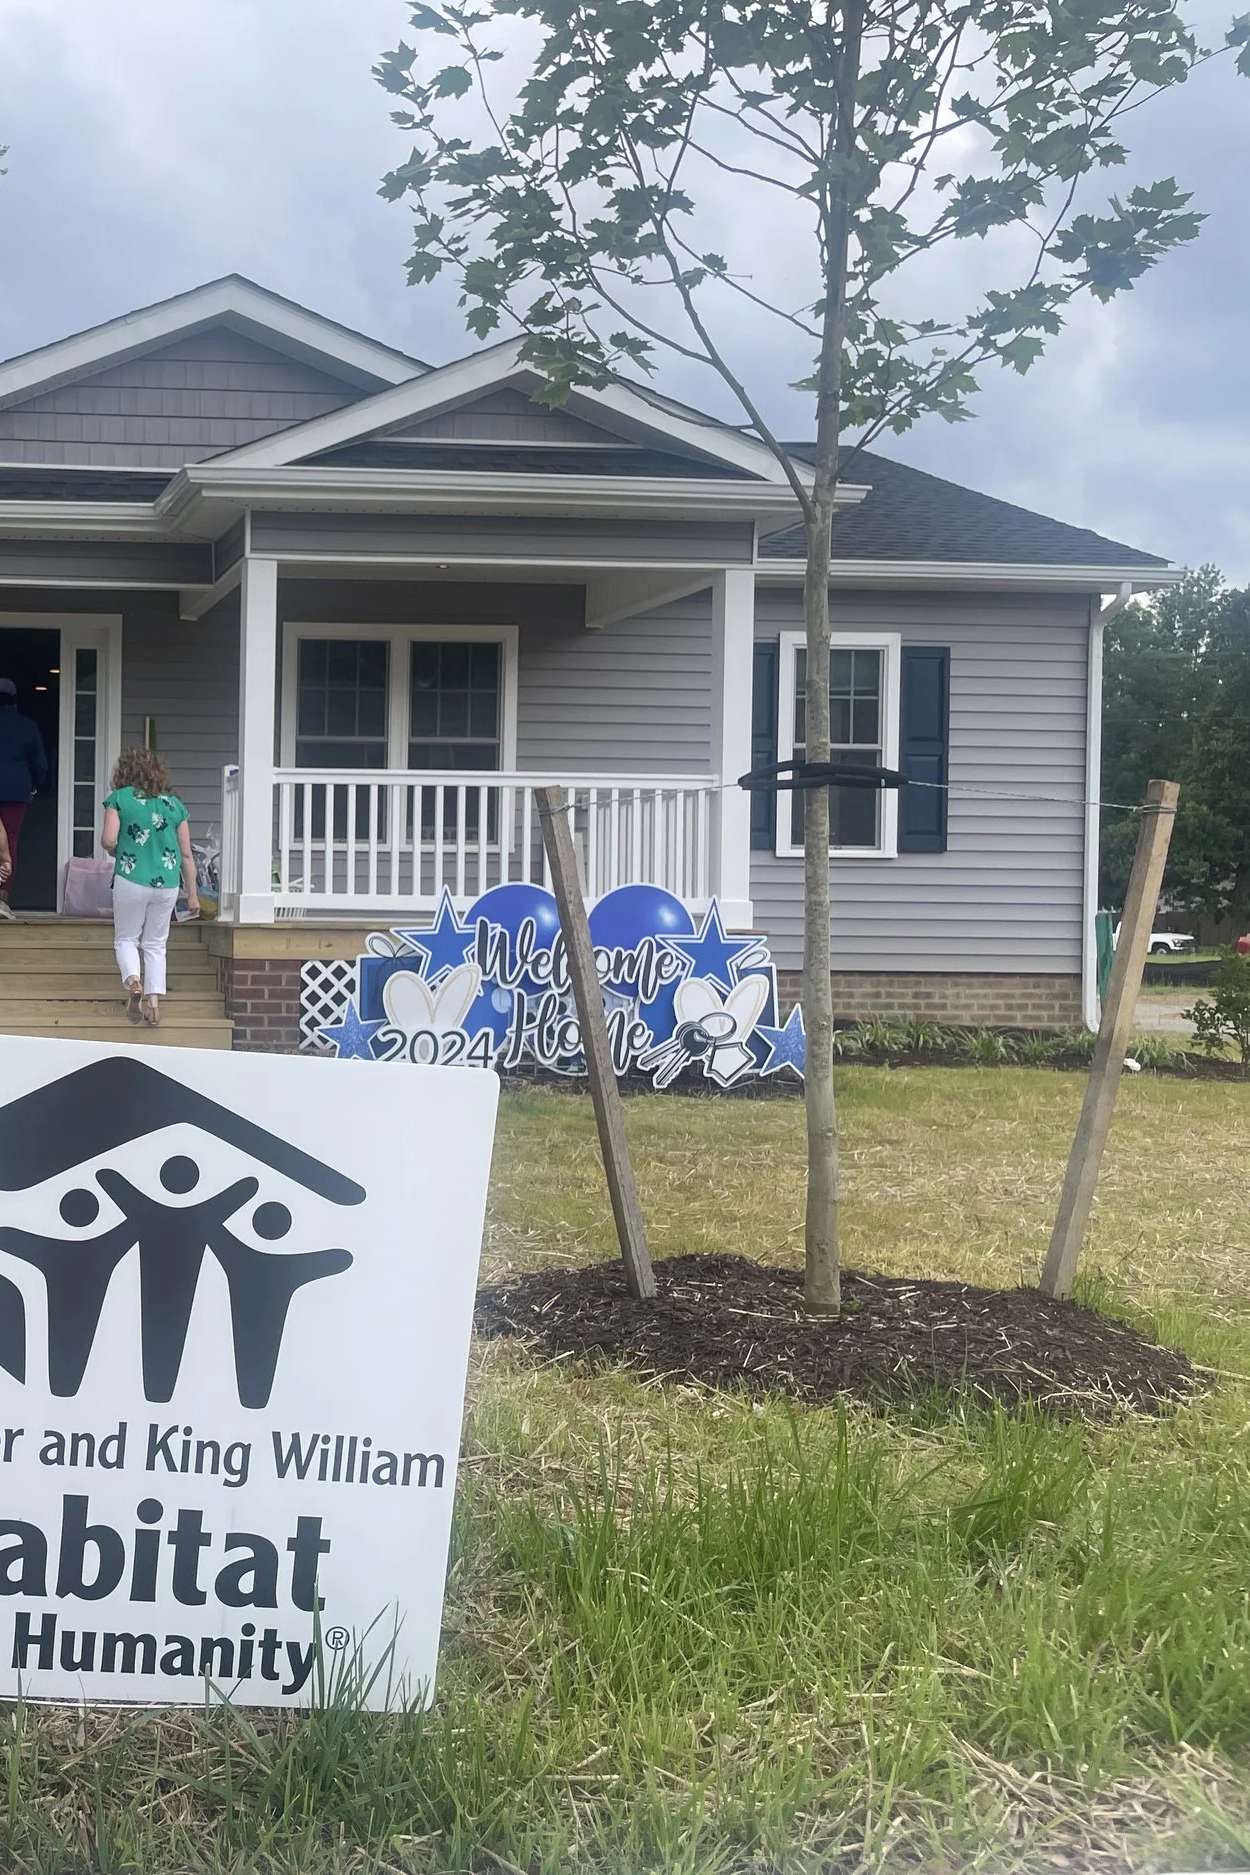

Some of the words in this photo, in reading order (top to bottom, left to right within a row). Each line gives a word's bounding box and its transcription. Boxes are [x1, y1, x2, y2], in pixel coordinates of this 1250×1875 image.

[476, 916, 682, 1001] Welome
[377, 1028, 494, 1068] 2024
[39, 1421, 127, 1470] and
[145, 1423, 251, 1488] King
[272, 1430, 445, 1488] William
